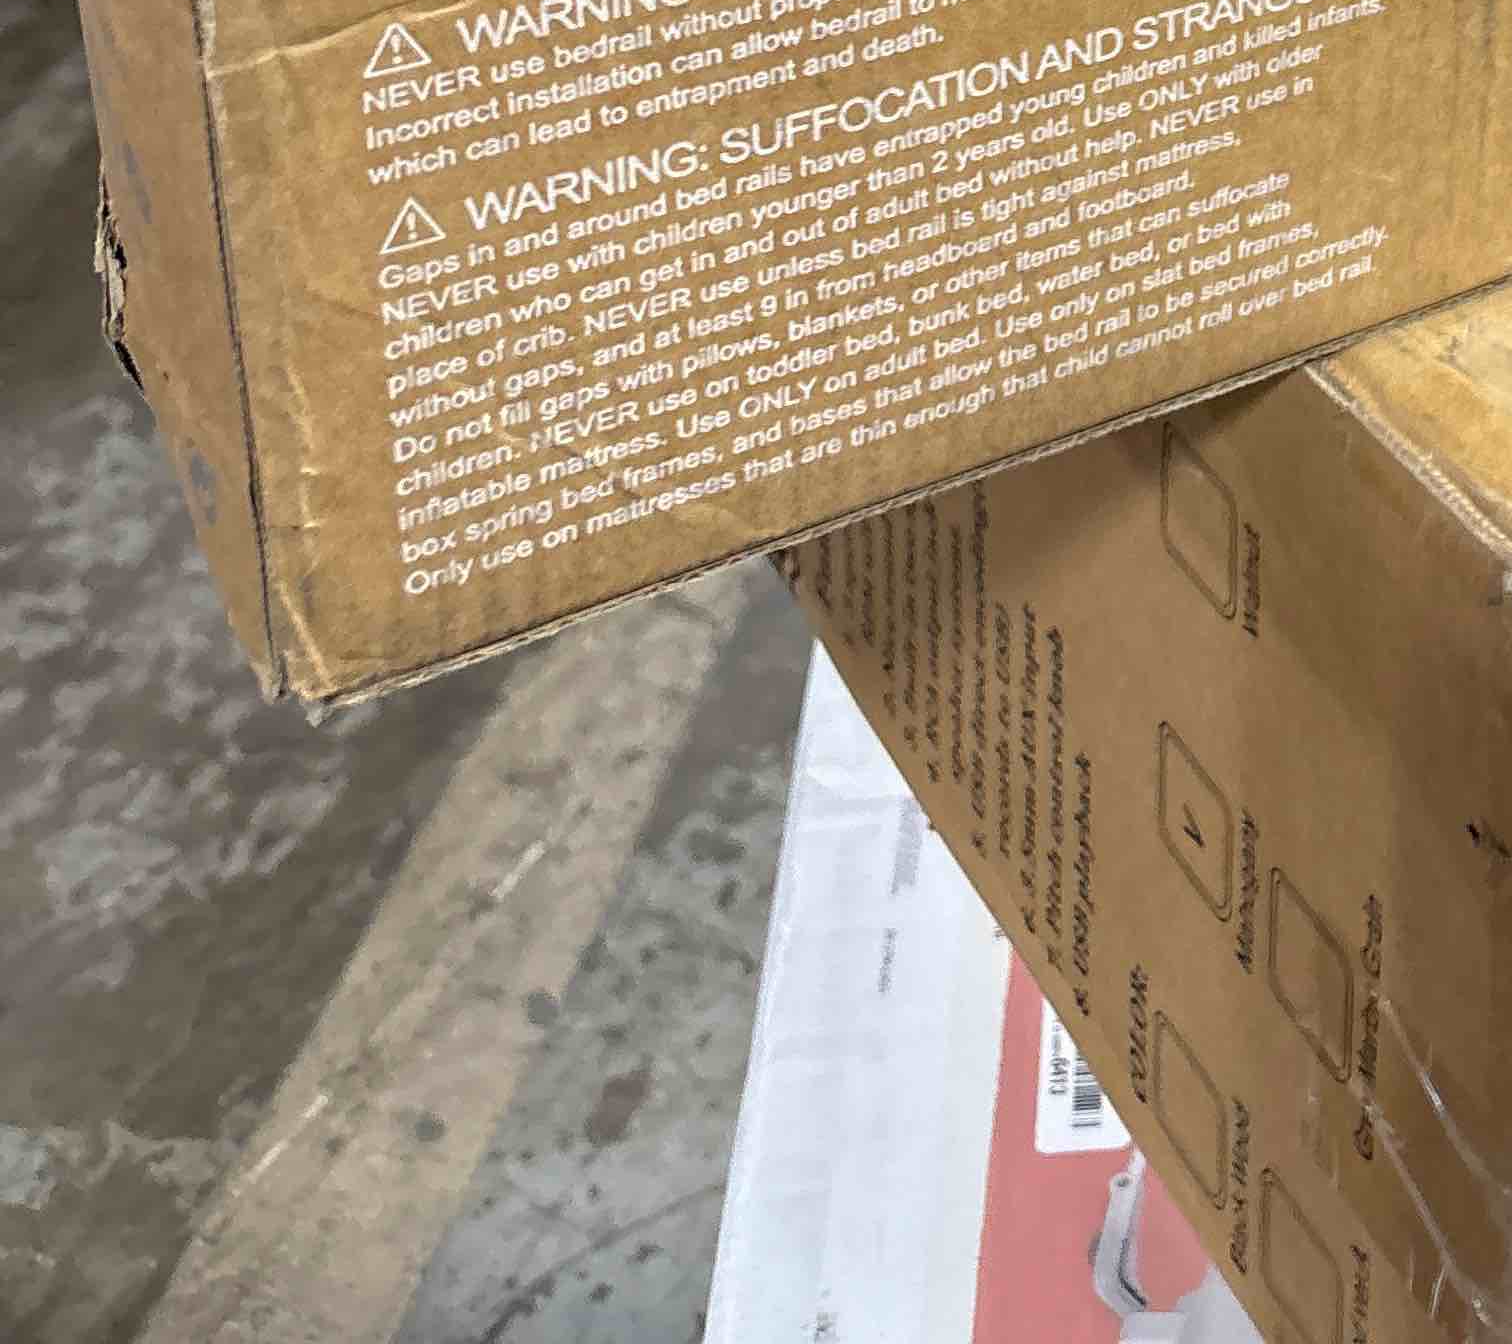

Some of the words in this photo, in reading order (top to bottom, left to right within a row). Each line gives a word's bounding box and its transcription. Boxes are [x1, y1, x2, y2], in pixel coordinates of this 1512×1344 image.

[360, 63, 483, 115] NEVER
[488, 53, 546, 84] use
[551, 22, 654, 69] bedrail
[364, 95, 502, 151] Incorrect
[505, 60, 664, 116] installation
[668, 46, 724, 75] can
[729, 24, 805, 61] allow
[365, 143, 458, 186] which
[463, 130, 521, 161] can
[527, 107, 592, 146] lead
[597, 103, 629, 128] to
[633, 57, 798, 120] entrapment
[800, 41, 856, 77] and
[860, 22, 945, 62] death.
[376, 253, 461, 290] Gaps
[465, 241, 496, 267] in
[502, 220, 560, 258] and
[565, 190, 668, 241] around
[673, 174, 728, 211] bed
[733, 162, 794, 196] rails
[798, 144, 867, 178] have
[871, 99, 1004, 159] entrapped
[1007, 81, 1086, 124] young
[1090, 52, 1188, 95] children
[1190, 31, 1238, 66] and
[1241, 13, 1302, 52] killed
[379, 272, 499, 326] NEVER
[504, 260, 561, 292] use
[564, 239, 626, 274] with
[631, 210, 744, 256] children
[749, 177, 863, 231] younger
[864, 160, 925, 193] than
[929, 148, 949, 174] 2
[953, 130, 1026, 172] years
[1029, 112, 1076, 144] old.
[1081, 100, 1133, 129] Use
[1136, 71, 1209, 112] ONLY
[1211, 59, 1261, 89] with
[1264, 42, 1325, 75] older
[462, 138, 710, 232] WARNING:
[718, 47, 1028, 165] SUFFOCATION
[1033, 25, 1125, 81] AND
[381, 310, 504, 361] children
[506, 291, 573, 324] who
[577, 274, 632, 304] can
[637, 255, 685, 293] get
[689, 248, 717, 273] in
[721, 228, 775, 265] and
[780, 216, 827, 247] out
[830, 204, 860, 233] of
[864, 186, 930, 225] adult
[934, 168, 984, 204] bed
[988, 142, 1080, 187] without
[1082, 128, 1143, 159] help.
[1148, 93, 1241, 140] NEVER
[1244, 83, 1288, 111] use
[1291, 74, 1314, 97] in
[384, 354, 469, 401] place
[474, 335, 506, 368] of
[510, 323, 576, 357] crib.
[581, 286, 693, 338] NEVER
[698, 273, 751, 303] use
[755, 246, 845, 287] unless
[849, 225, 901, 260] bed
[905, 211, 947, 244] rail
[951, 206, 975, 230] is
[979, 186, 1035, 223] tight
[1038, 158, 1130, 204] against
[1133, 129, 1242, 175] mattress,
[387, 375, 496, 429] without
[502, 357, 585, 399] gaps,
[589, 330, 646, 368] and
[651, 321, 682, 350] at
[685, 300, 755, 339] least
[758, 293, 778, 319] 9
[783, 286, 809, 311] in
[814, 269, 876, 301] from
[881, 221, 1019, 283] headboard
[1022, 205, 1072, 239] and
[1075, 167, 1196, 223] footboard.
